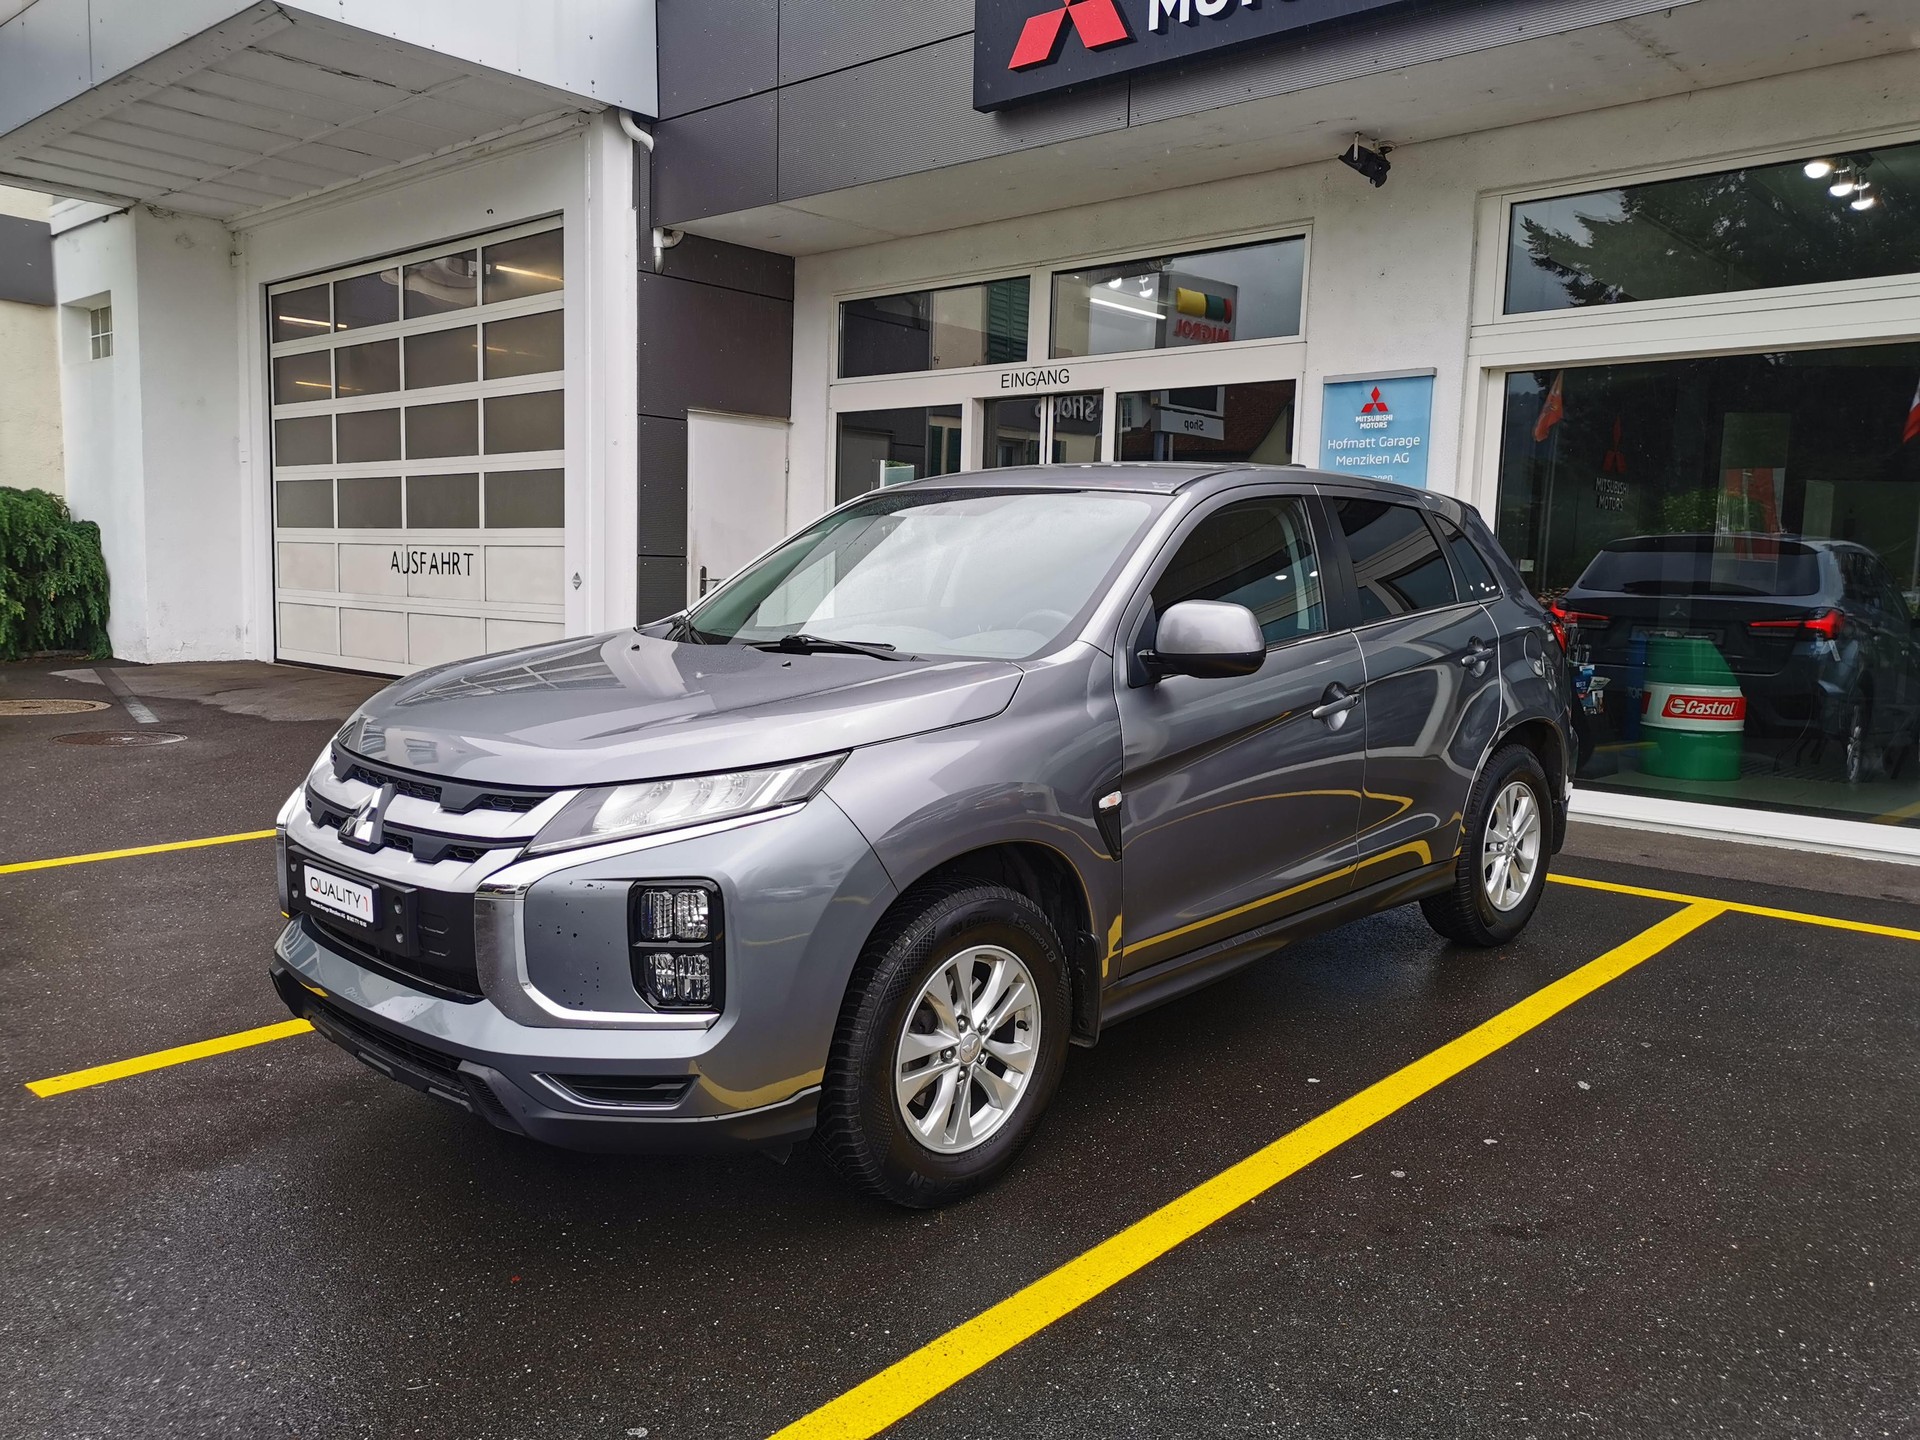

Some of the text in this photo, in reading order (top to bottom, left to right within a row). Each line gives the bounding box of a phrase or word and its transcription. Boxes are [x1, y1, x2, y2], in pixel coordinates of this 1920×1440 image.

[1001, 368, 1070, 388] EINGANG
[1355, 414, 1393, 423] MITSUBISHI
[1360, 421, 1387, 429] MOTORS
[1327, 436, 1421, 450] Hofmatt Garage
[1335, 452, 1410, 466] Menziken AG
[1595, 476, 1629, 496] MITSUBISHI
[1599, 494, 1624, 511] MOTORS
[390, 550, 474, 577] AUSFAHRT
[1685, 700, 1735, 716] Castrol
[310, 876, 369, 913] QUALITY 1
